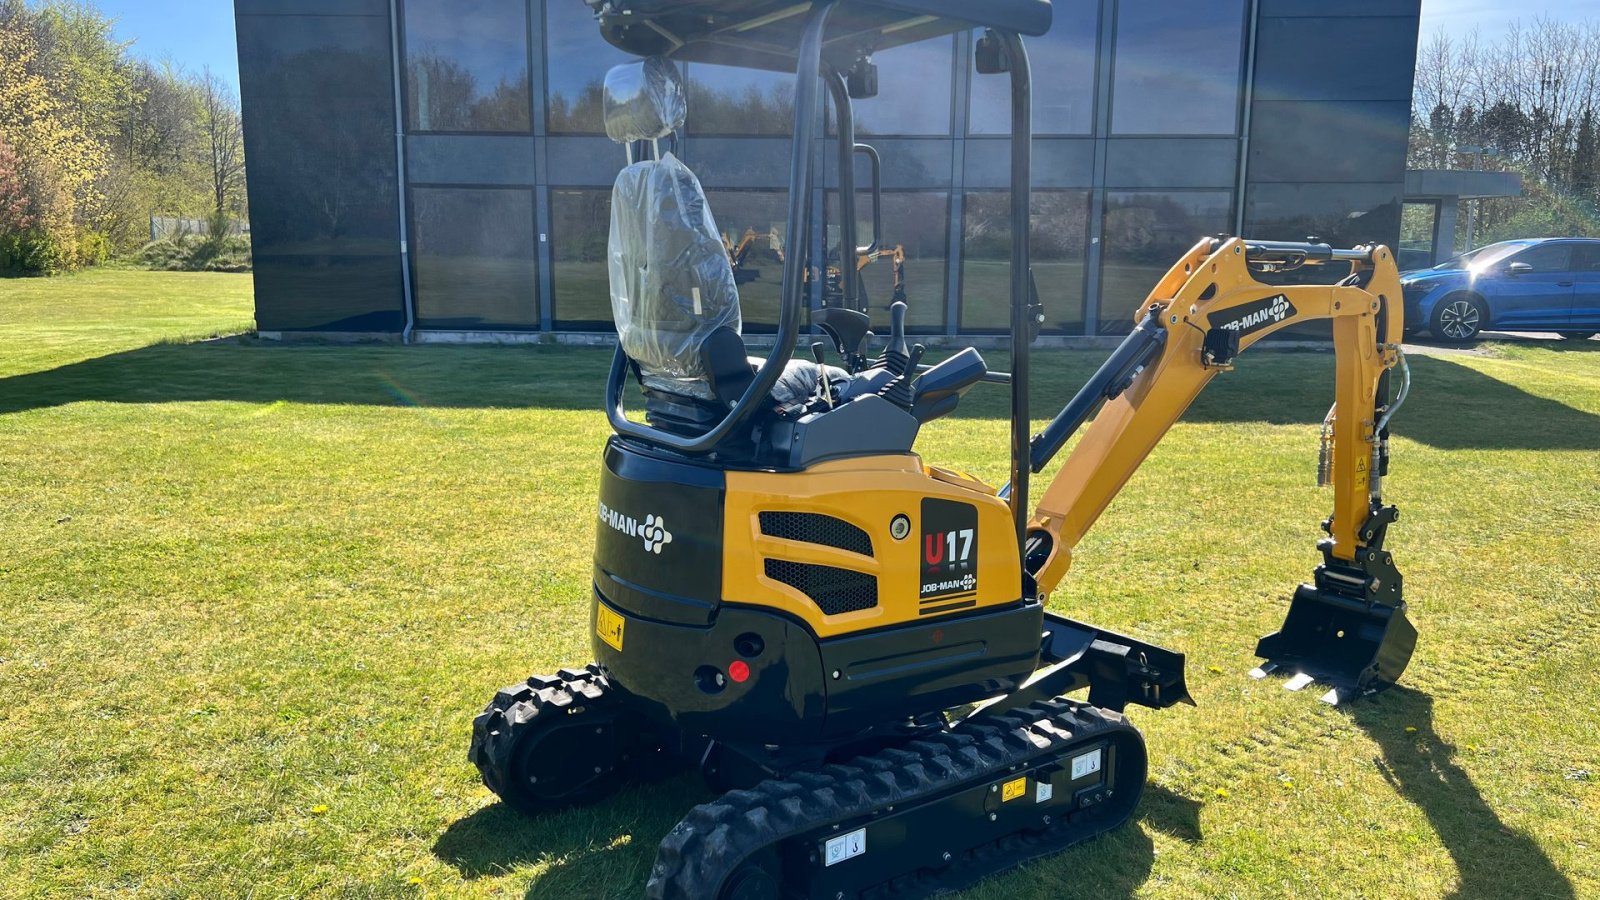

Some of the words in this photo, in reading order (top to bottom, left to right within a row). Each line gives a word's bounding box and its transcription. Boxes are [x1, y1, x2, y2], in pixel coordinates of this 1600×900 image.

[1220, 308, 1268, 331] OB-MAN
[599, 501, 637, 537] OB-MAN
[925, 528, 974, 566] U17
[920, 579, 960, 594] JOB-MAN
